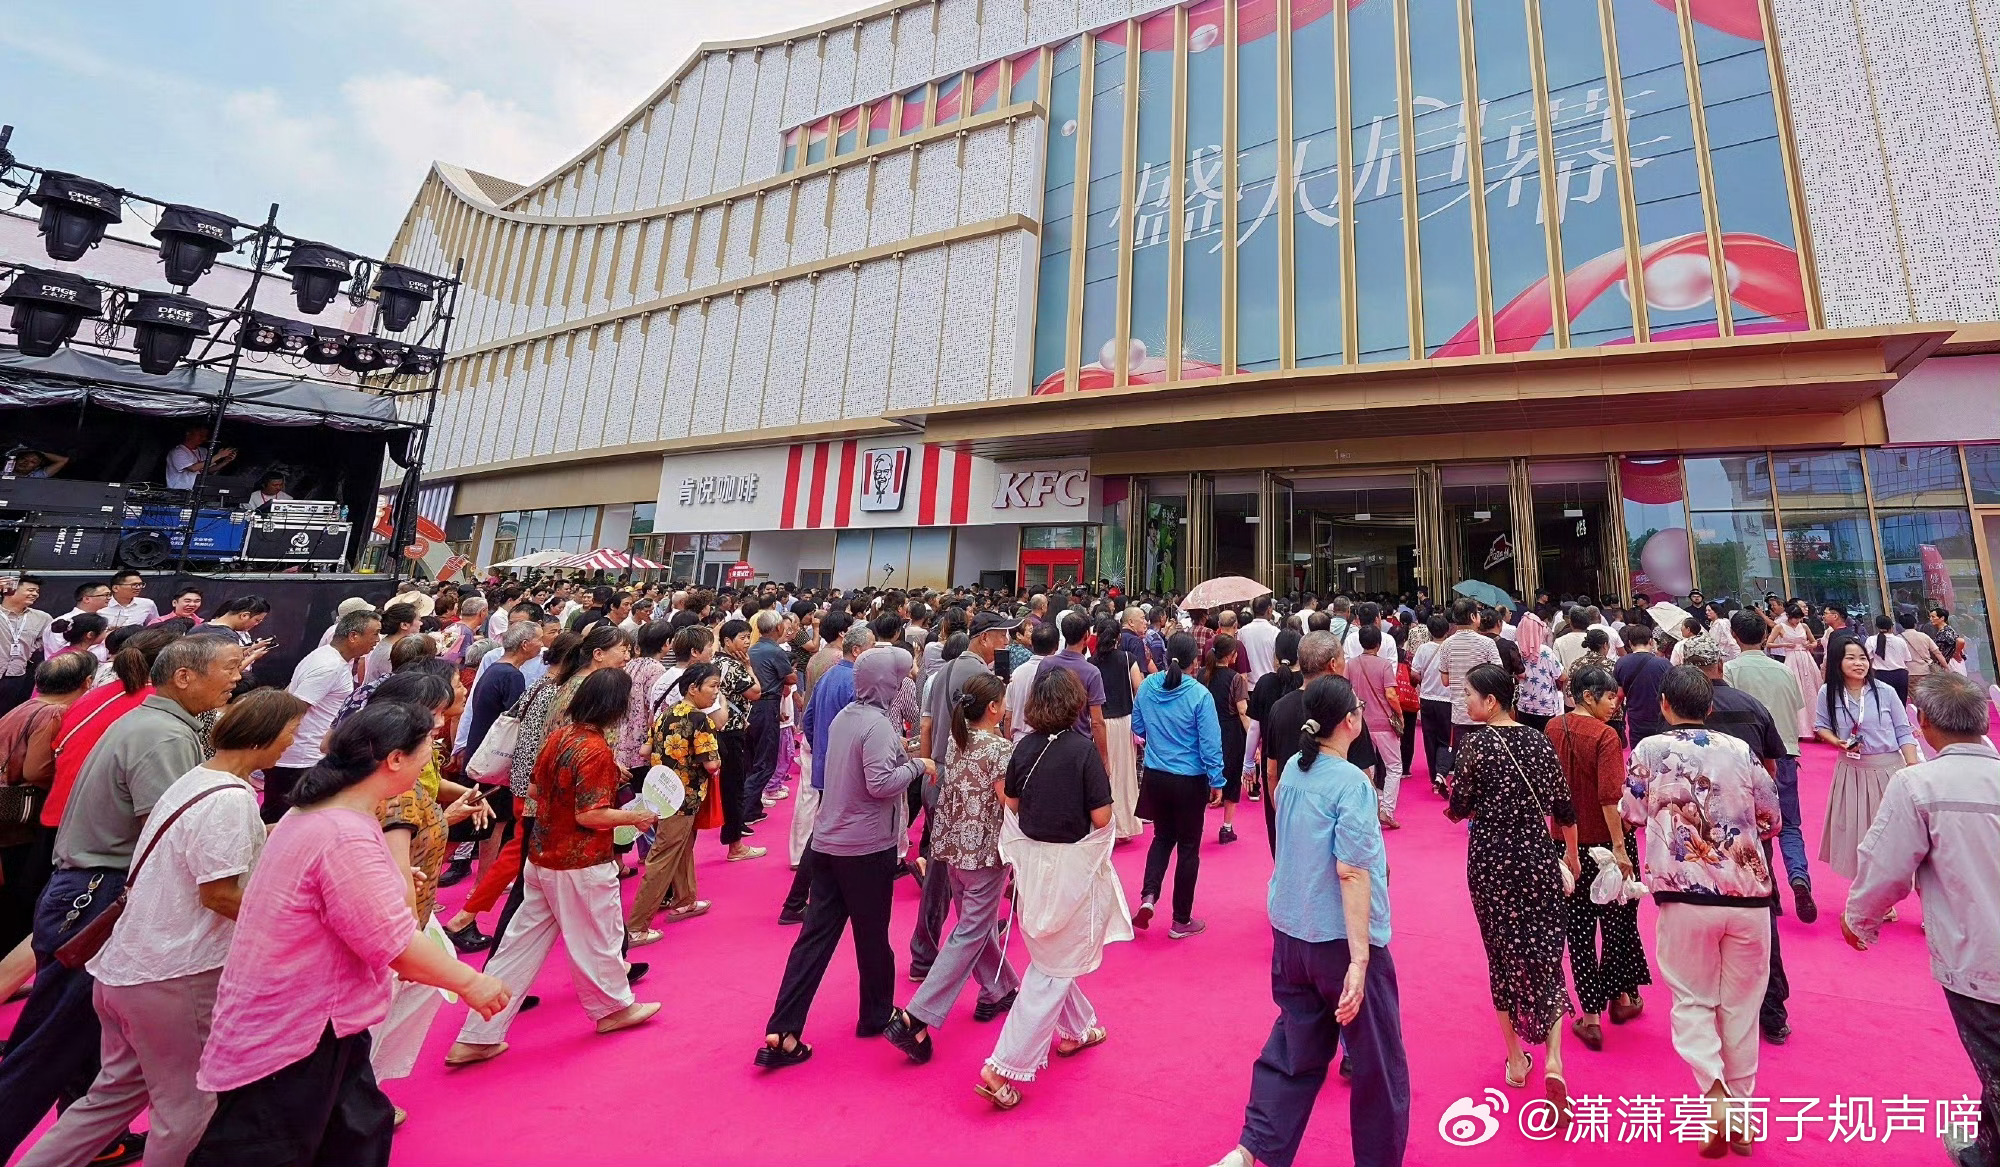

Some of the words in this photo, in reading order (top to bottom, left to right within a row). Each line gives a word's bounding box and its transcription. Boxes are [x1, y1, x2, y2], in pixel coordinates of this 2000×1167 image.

[42, 284, 77, 297] DAGE
[158, 306, 193, 318] DAGE
[680, 473, 759, 504] 肯悦咖啡
[992, 469, 1088, 508] KFC
